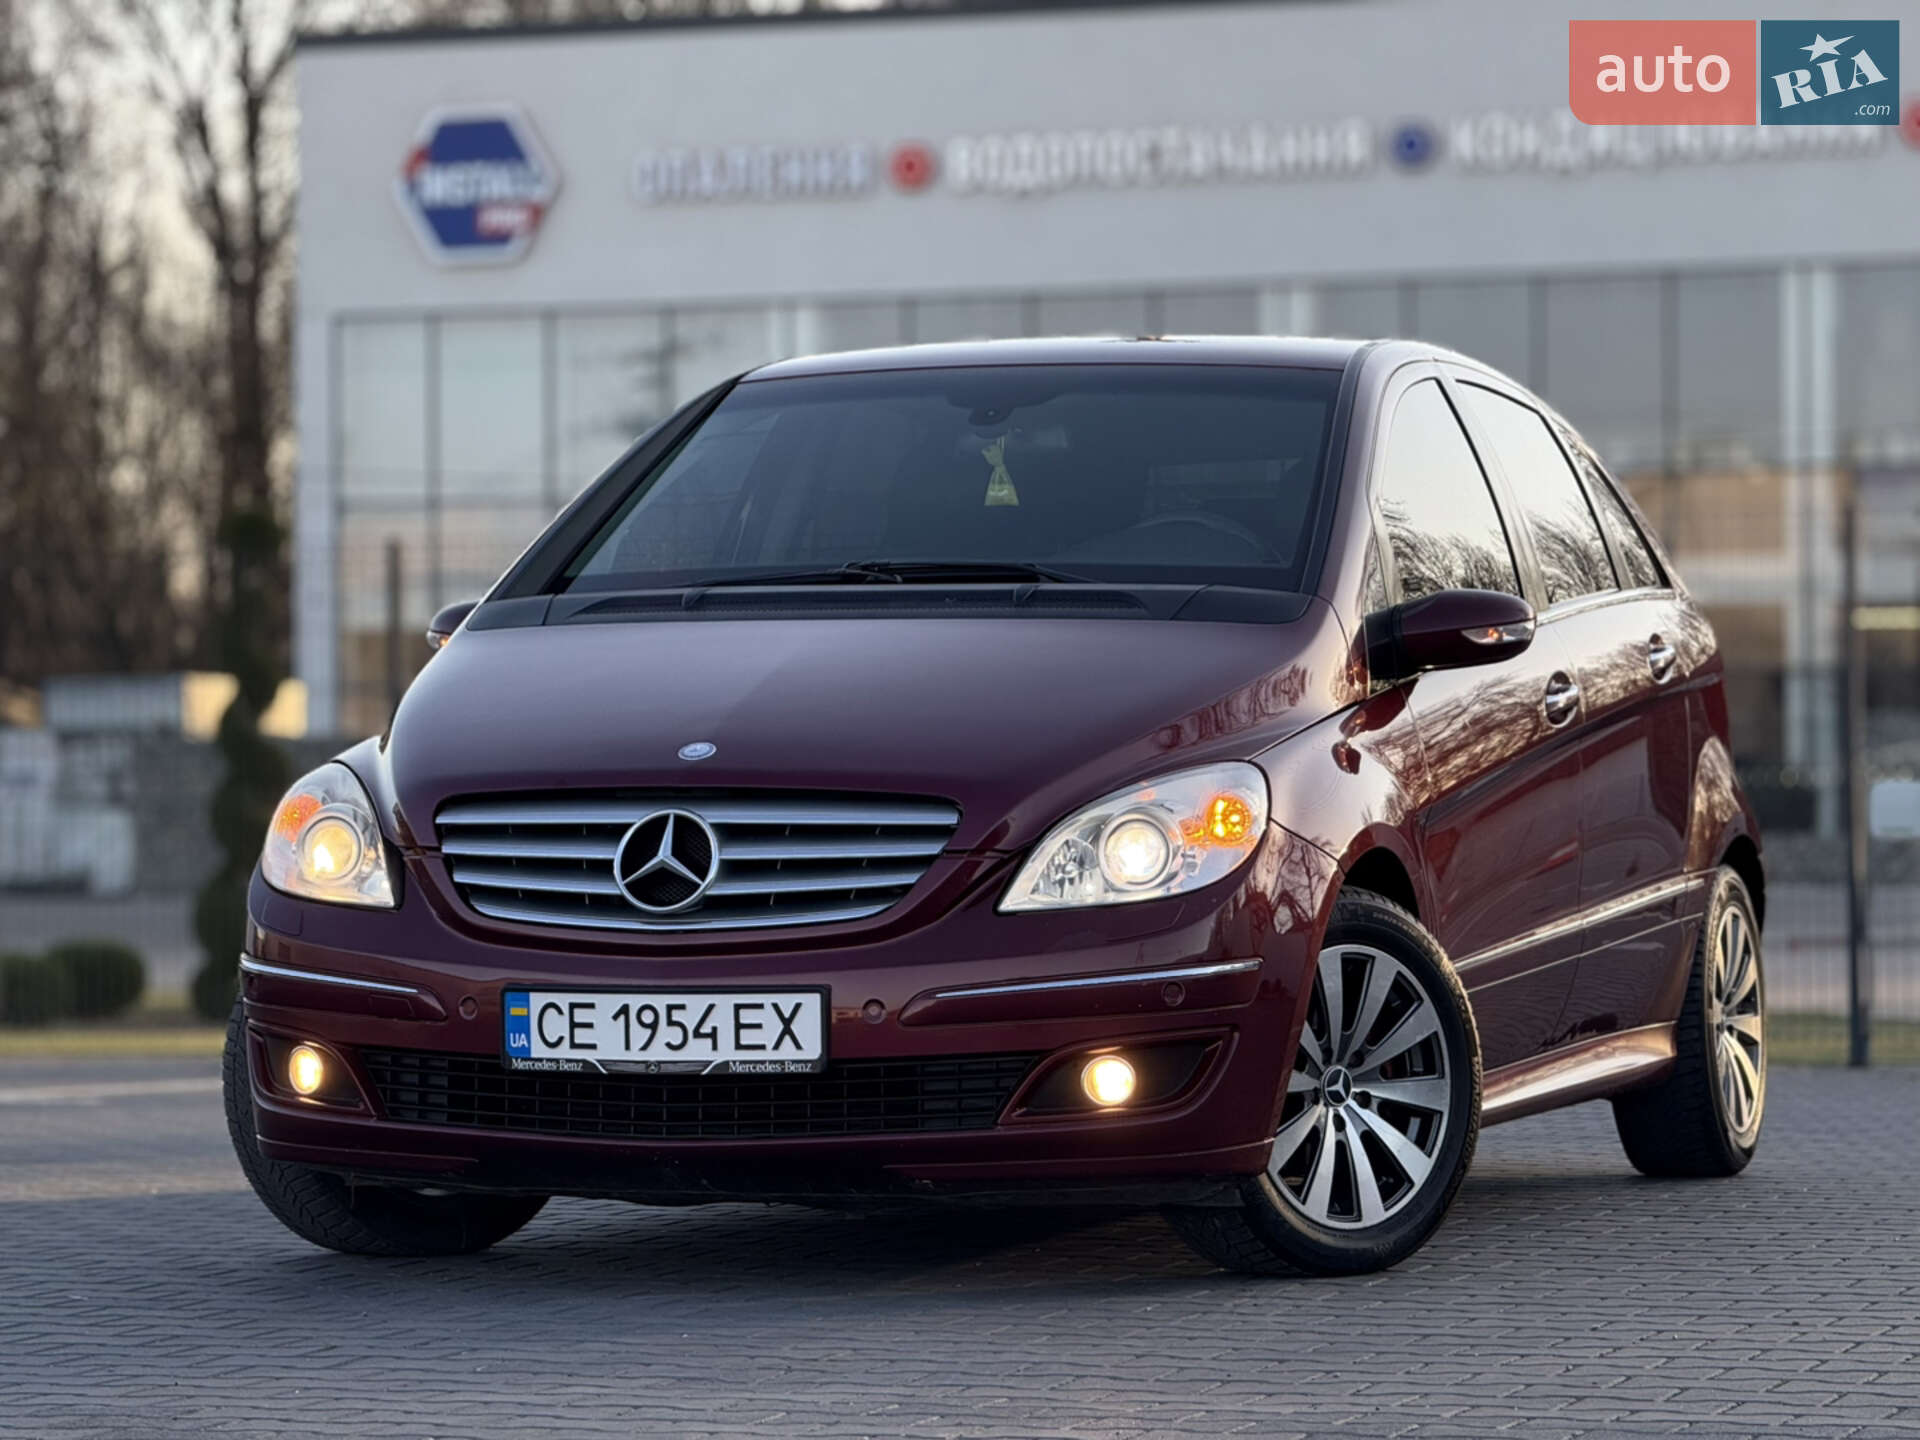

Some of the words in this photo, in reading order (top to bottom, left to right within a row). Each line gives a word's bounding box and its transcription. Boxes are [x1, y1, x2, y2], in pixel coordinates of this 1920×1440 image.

[537, 1002, 598, 1049] CE
[612, 1003, 718, 1051] 1954
[733, 1003, 803, 1050] EX
[510, 1034, 528, 1047] UA
[511, 1059, 583, 1071] Mercedes-Benz
[728, 1061, 811, 1073] Mercedes-Benz
